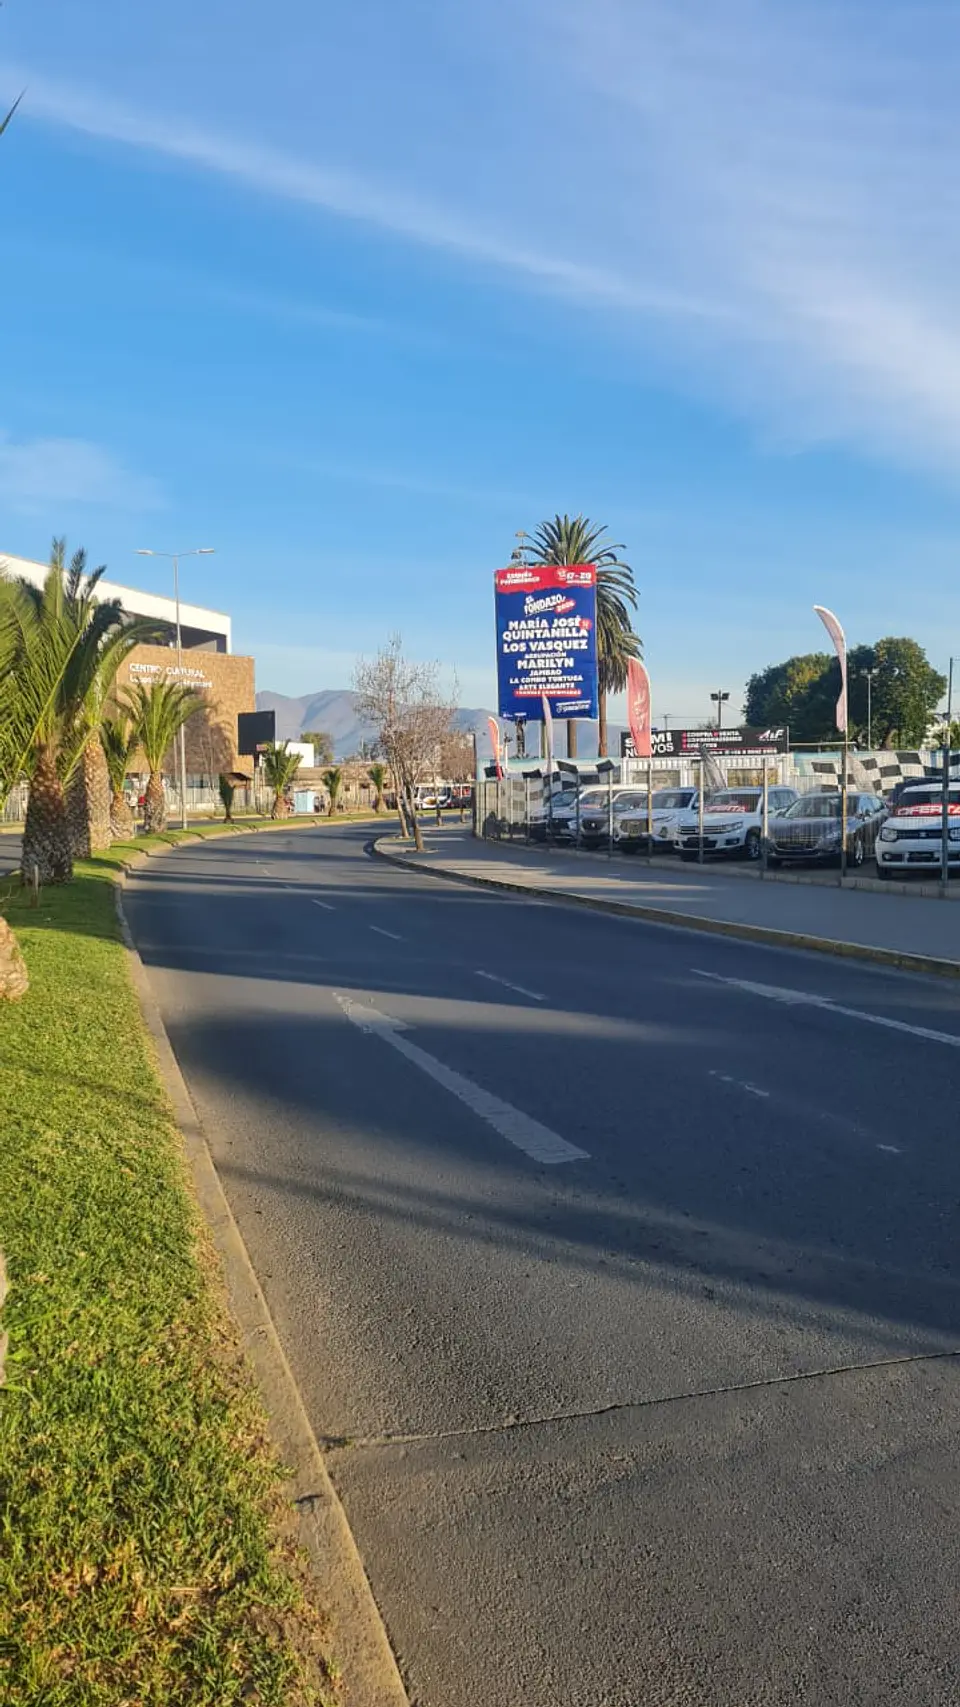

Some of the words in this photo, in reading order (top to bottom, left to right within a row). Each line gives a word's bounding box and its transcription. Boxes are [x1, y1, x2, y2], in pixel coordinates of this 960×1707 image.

[508, 617, 549, 631] MARÍA
[552, 615, 581, 628] JOSÉ
[502, 628, 588, 642] QUINTANILLA
[503, 643, 527, 653] LOS
[529, 640, 588, 653] VASQUEZ
[129, 663, 162, 674] CENTRO
[165, 666, 206, 679] CULTURAL
[517, 658, 574, 670] MARILYN
[548, 675, 583, 683] TORTUGA
[624, 732, 672, 748] SMI
[625, 742, 674, 757] NVOS
